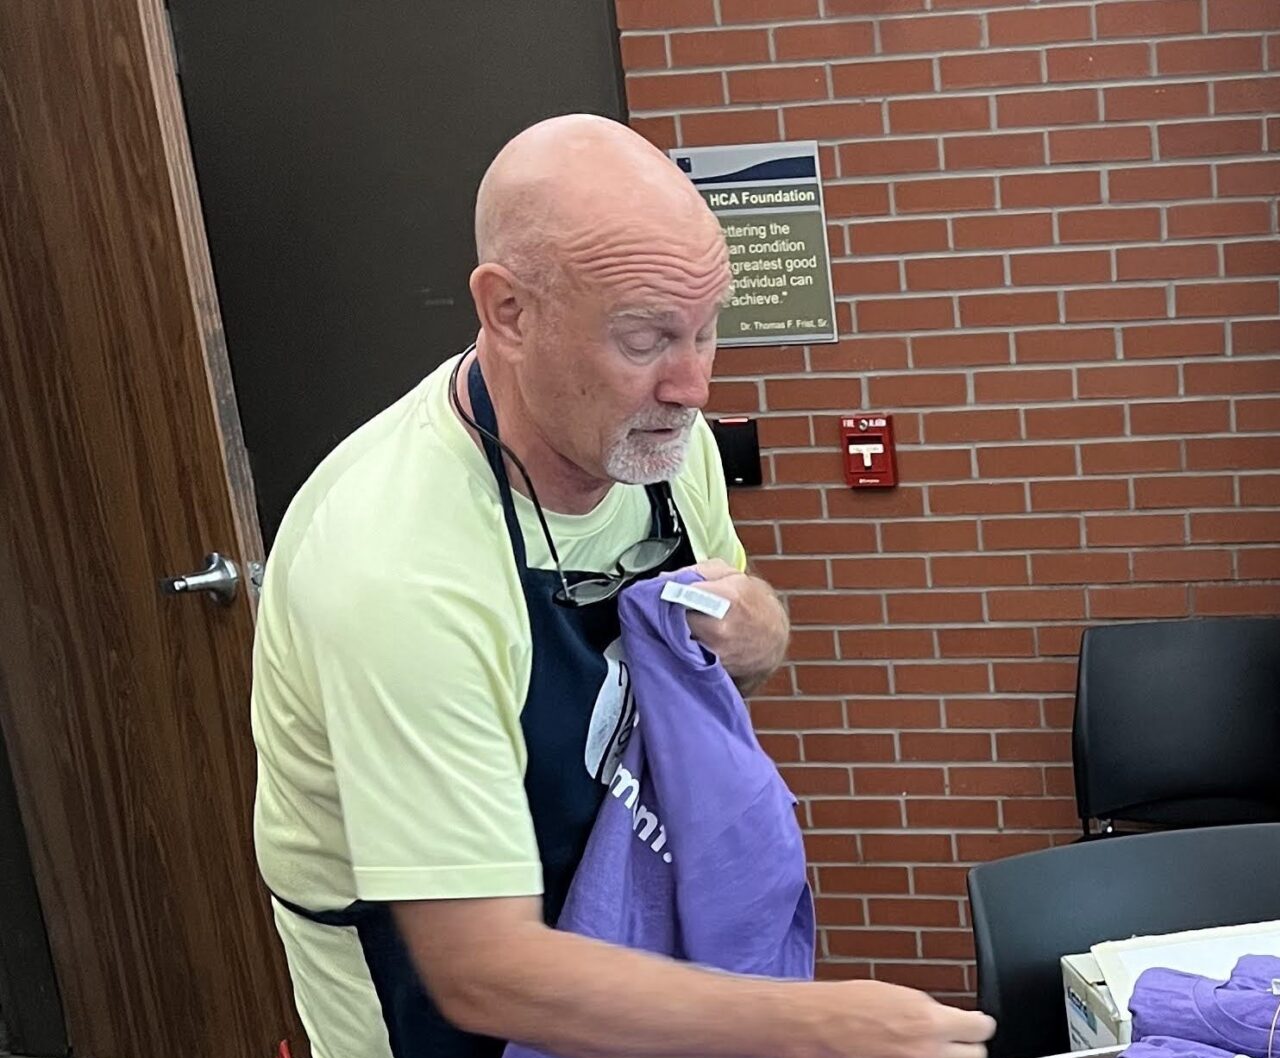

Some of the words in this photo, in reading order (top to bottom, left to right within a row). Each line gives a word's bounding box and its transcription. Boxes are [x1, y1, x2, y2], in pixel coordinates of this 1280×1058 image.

[710, 192, 739, 206] HCA
[741, 189, 815, 204] Foundation
[769, 222, 790, 235] the
[748, 239, 806, 254] condition
[731, 257, 783, 275] greatest
[785, 255, 817, 272] good
[789, 275, 813, 286] can
